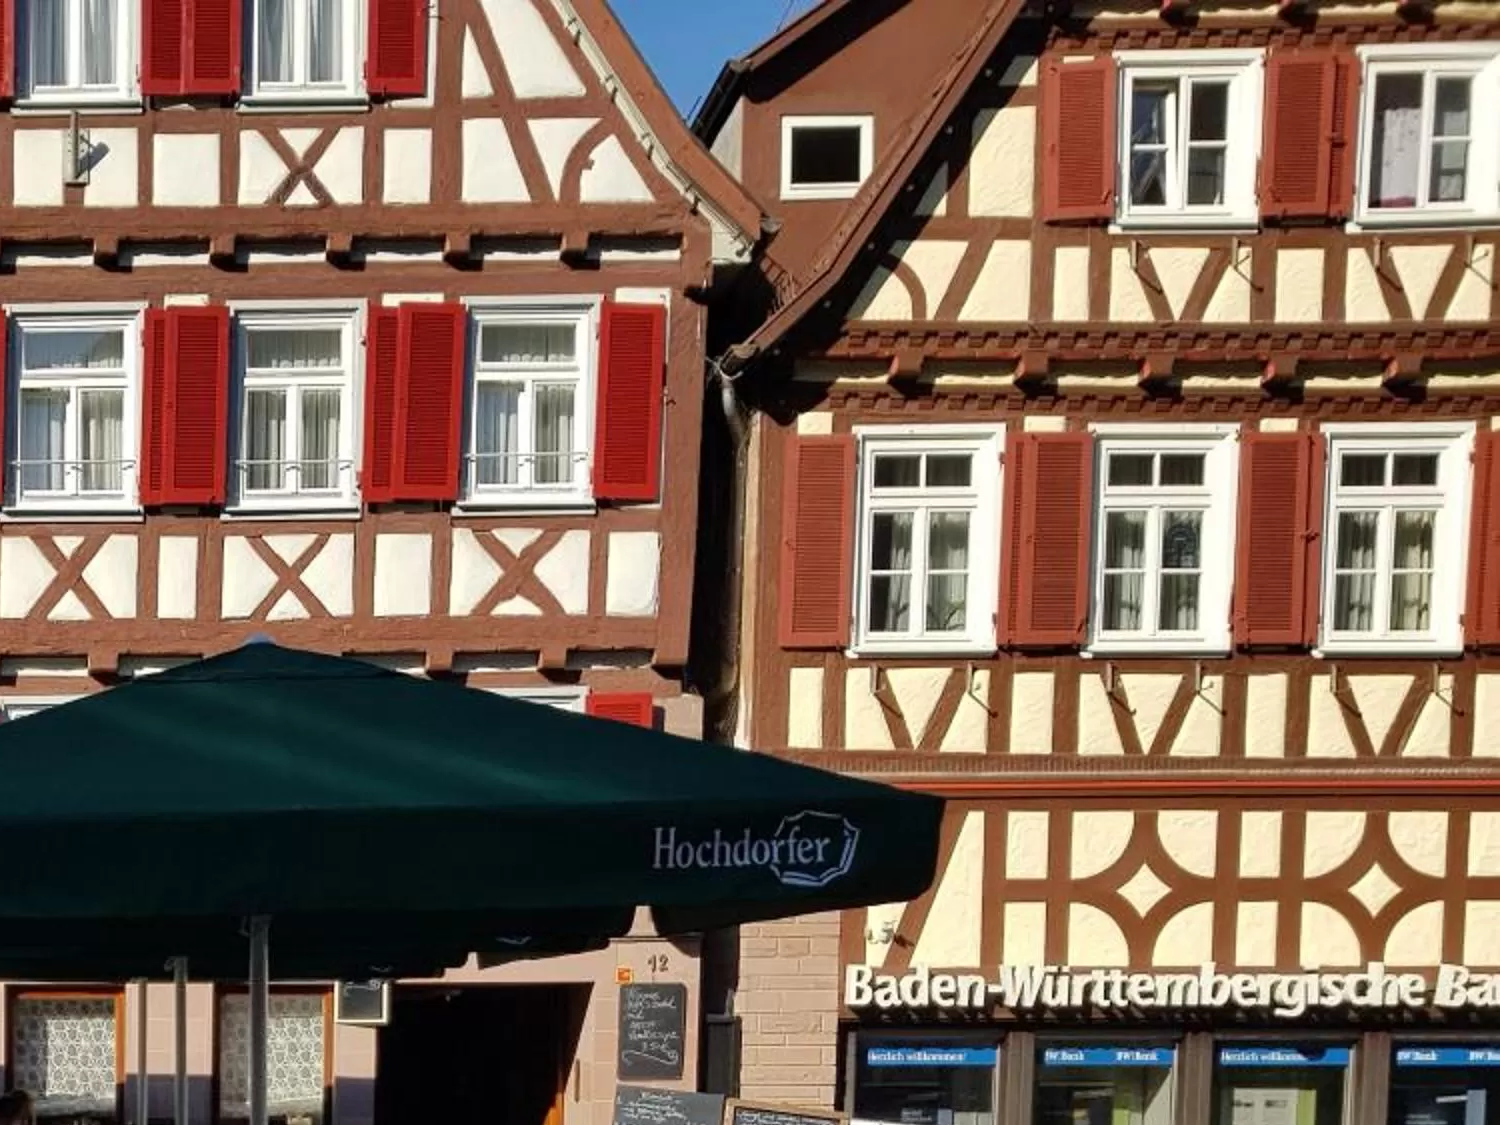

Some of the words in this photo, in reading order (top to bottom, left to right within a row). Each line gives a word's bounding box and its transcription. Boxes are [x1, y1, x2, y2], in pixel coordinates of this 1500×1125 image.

[652, 825, 831, 869] Hochdorfer
[647, 953, 669, 973] 12
[845, 961, 1426, 1018] Baden-Württembergische
[1434, 963, 1500, 1007] Ba
